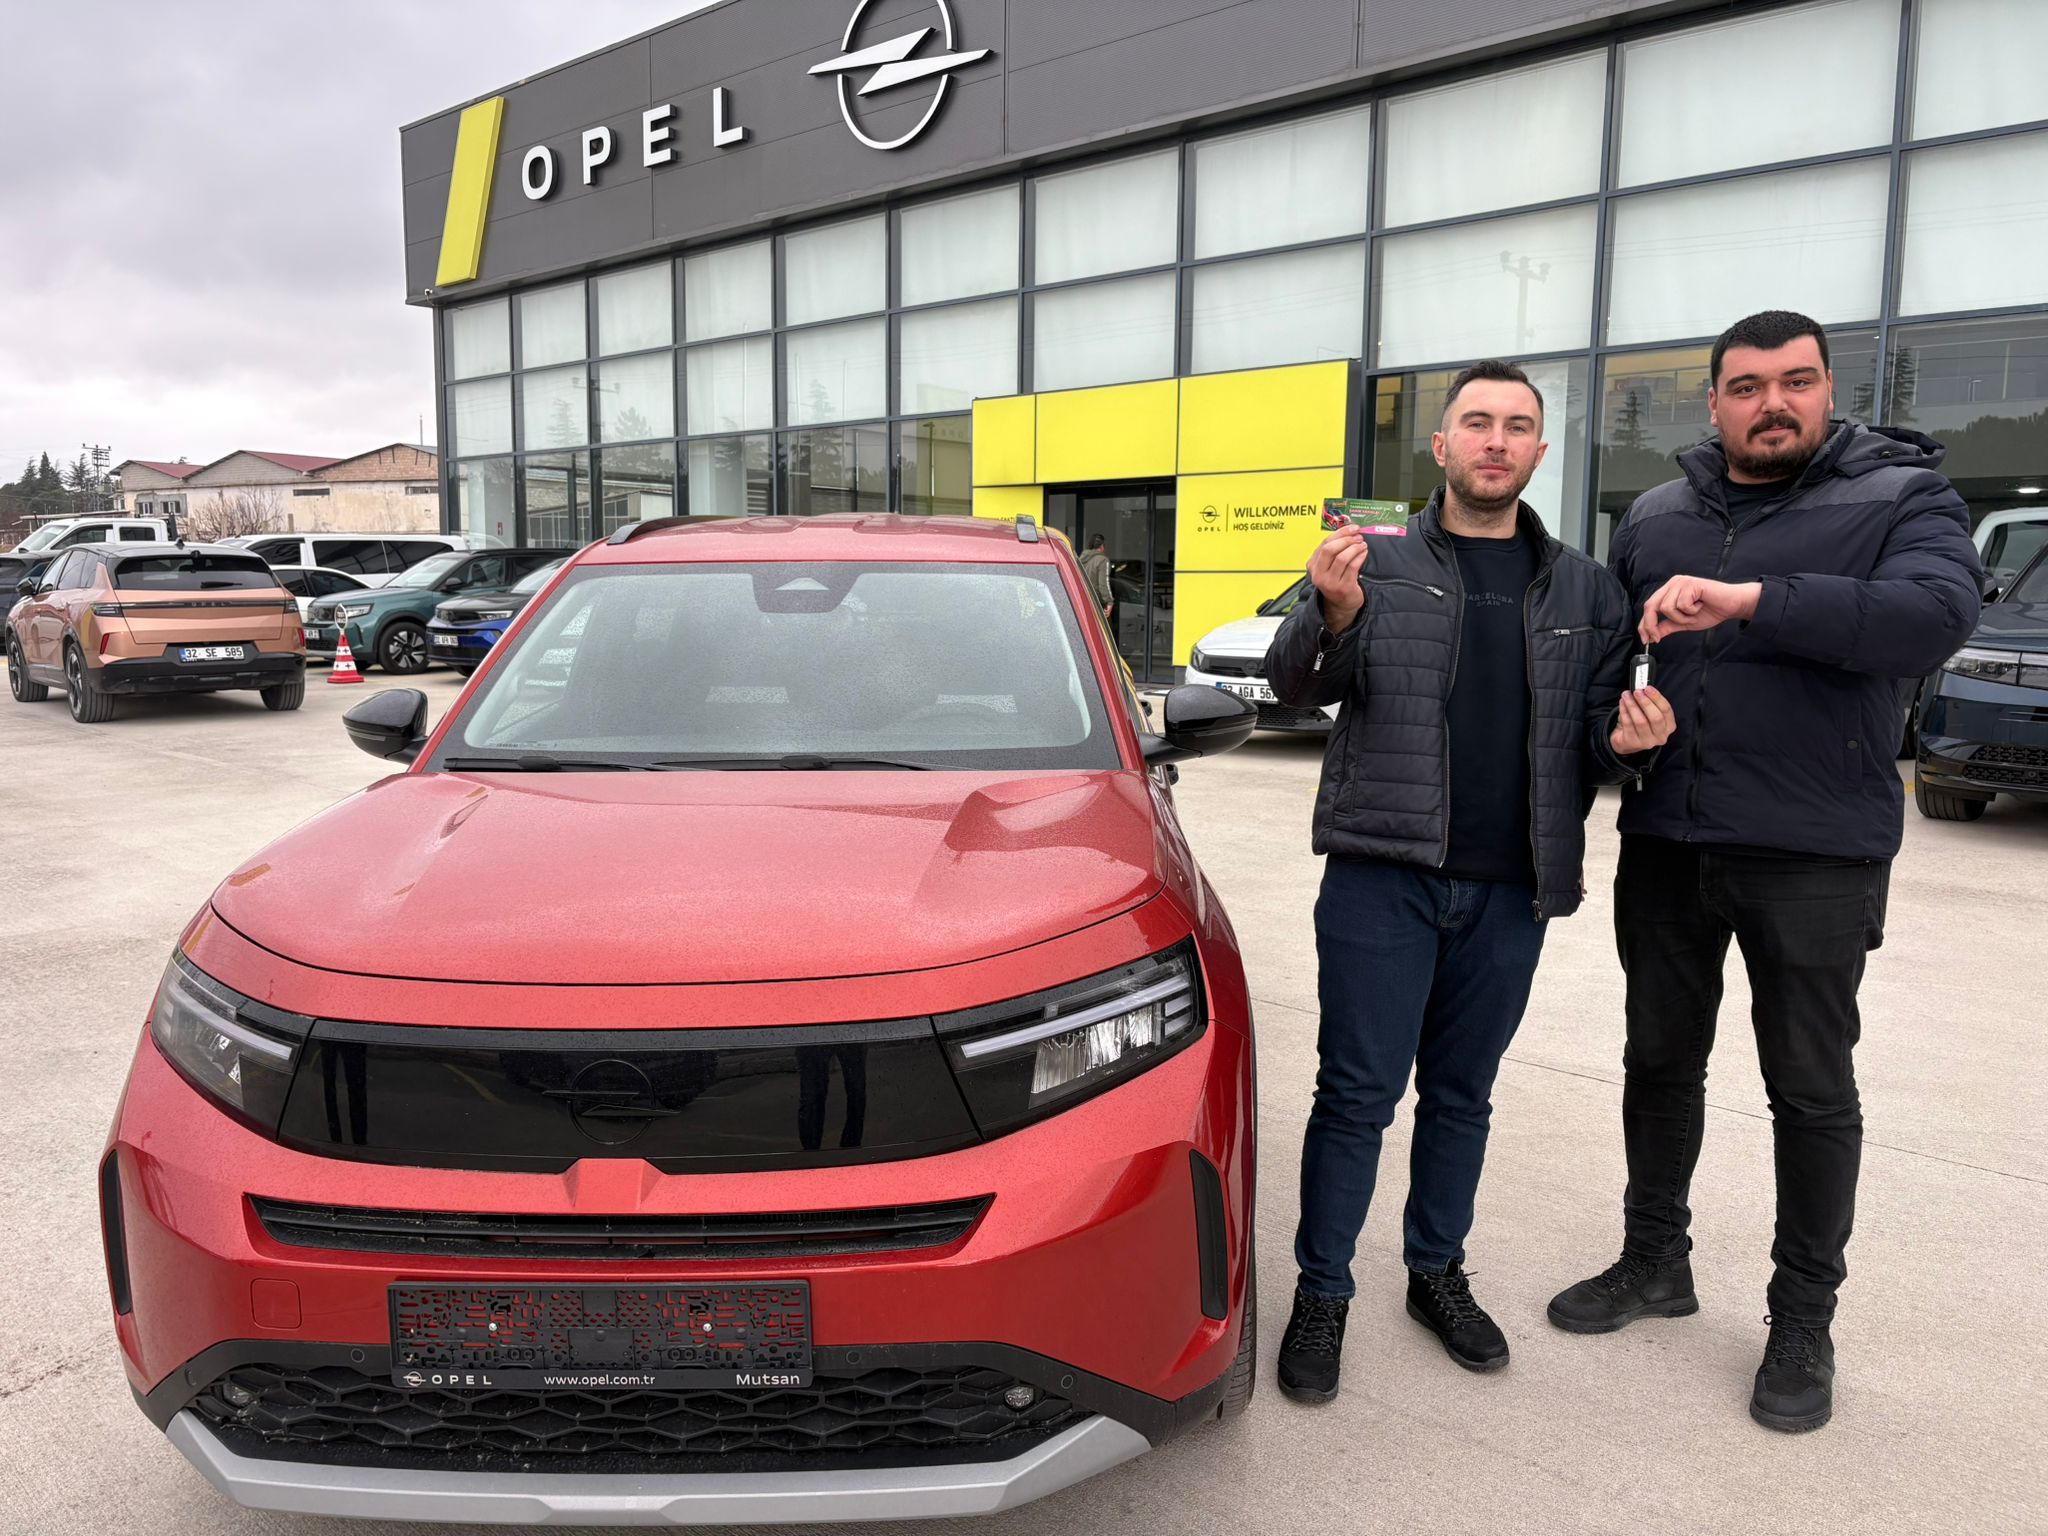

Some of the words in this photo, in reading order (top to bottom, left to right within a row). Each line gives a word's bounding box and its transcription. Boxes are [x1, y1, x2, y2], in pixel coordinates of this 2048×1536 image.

[521, 86, 745, 200] OPEL
[1233, 504, 1317, 518] WILLKOMMEN
[1233, 522, 1249, 532] HOŞ
[1250, 520, 1285, 531] GELDİNİZ
[186, 648, 198, 658] 32
[205, 648, 217, 657] SE
[225, 647, 242, 657] 585
[1239, 686, 1254, 698] AGA
[431, 1374, 493, 1386] OPEL
[543, 1374, 656, 1388] www.opel.com.tr
[735, 1373, 801, 1386] Mutsan
